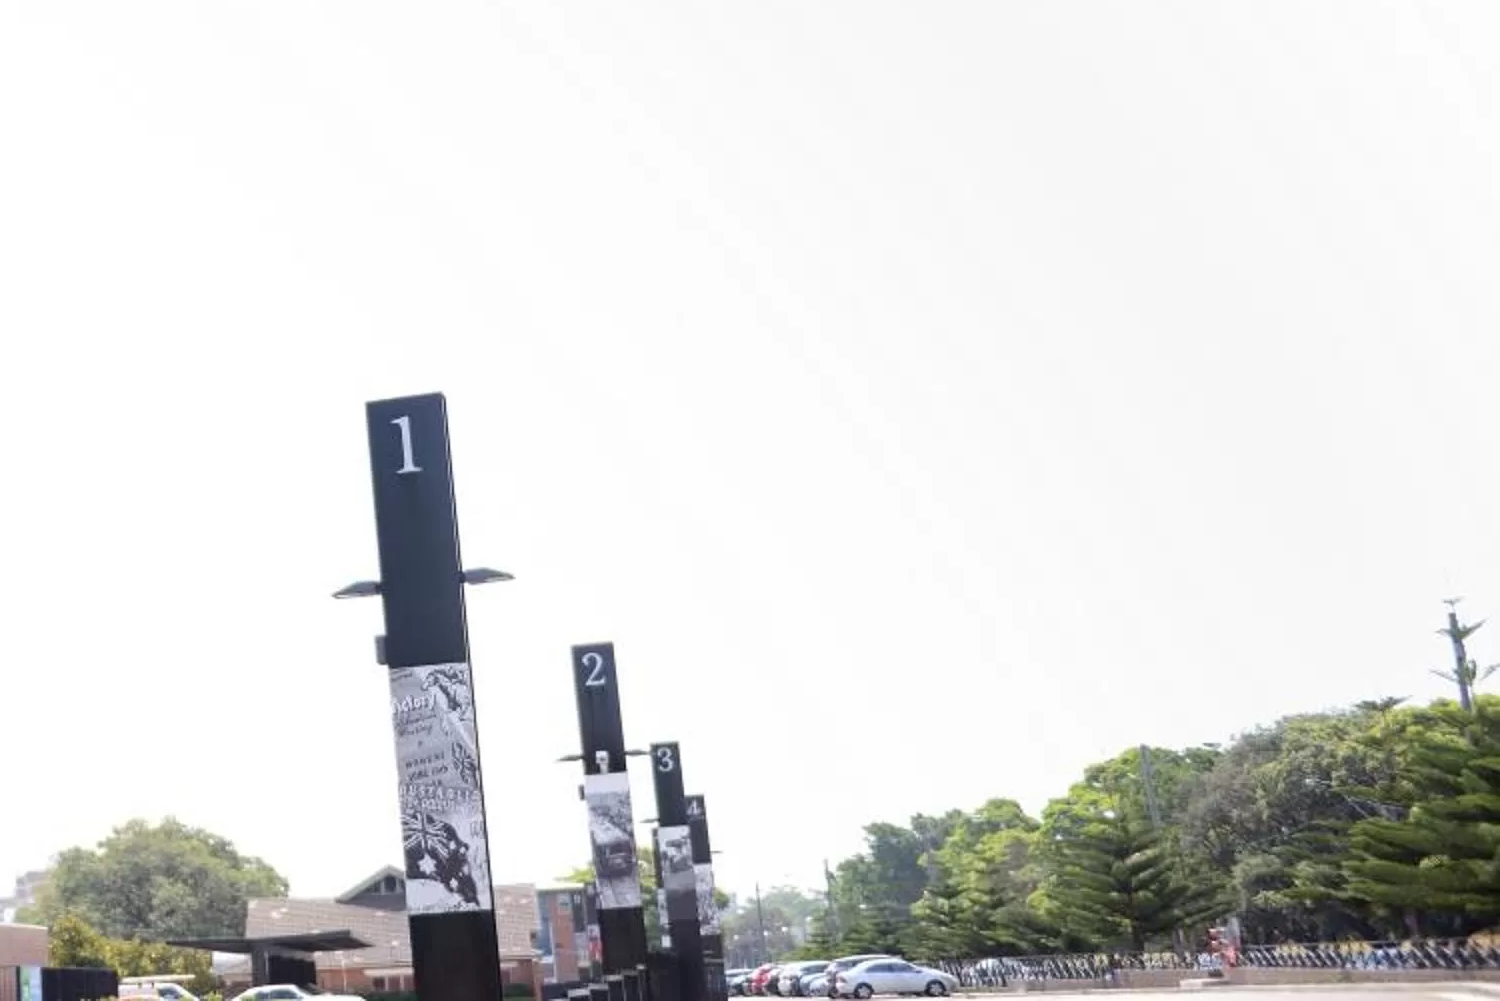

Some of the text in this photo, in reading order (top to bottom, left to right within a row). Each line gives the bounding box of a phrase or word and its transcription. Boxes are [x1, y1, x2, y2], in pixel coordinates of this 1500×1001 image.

[390, 415, 424, 474] 1
[581, 652, 607, 686] 2
[657, 747, 674, 772] 3
[686, 800, 700, 815] 4
